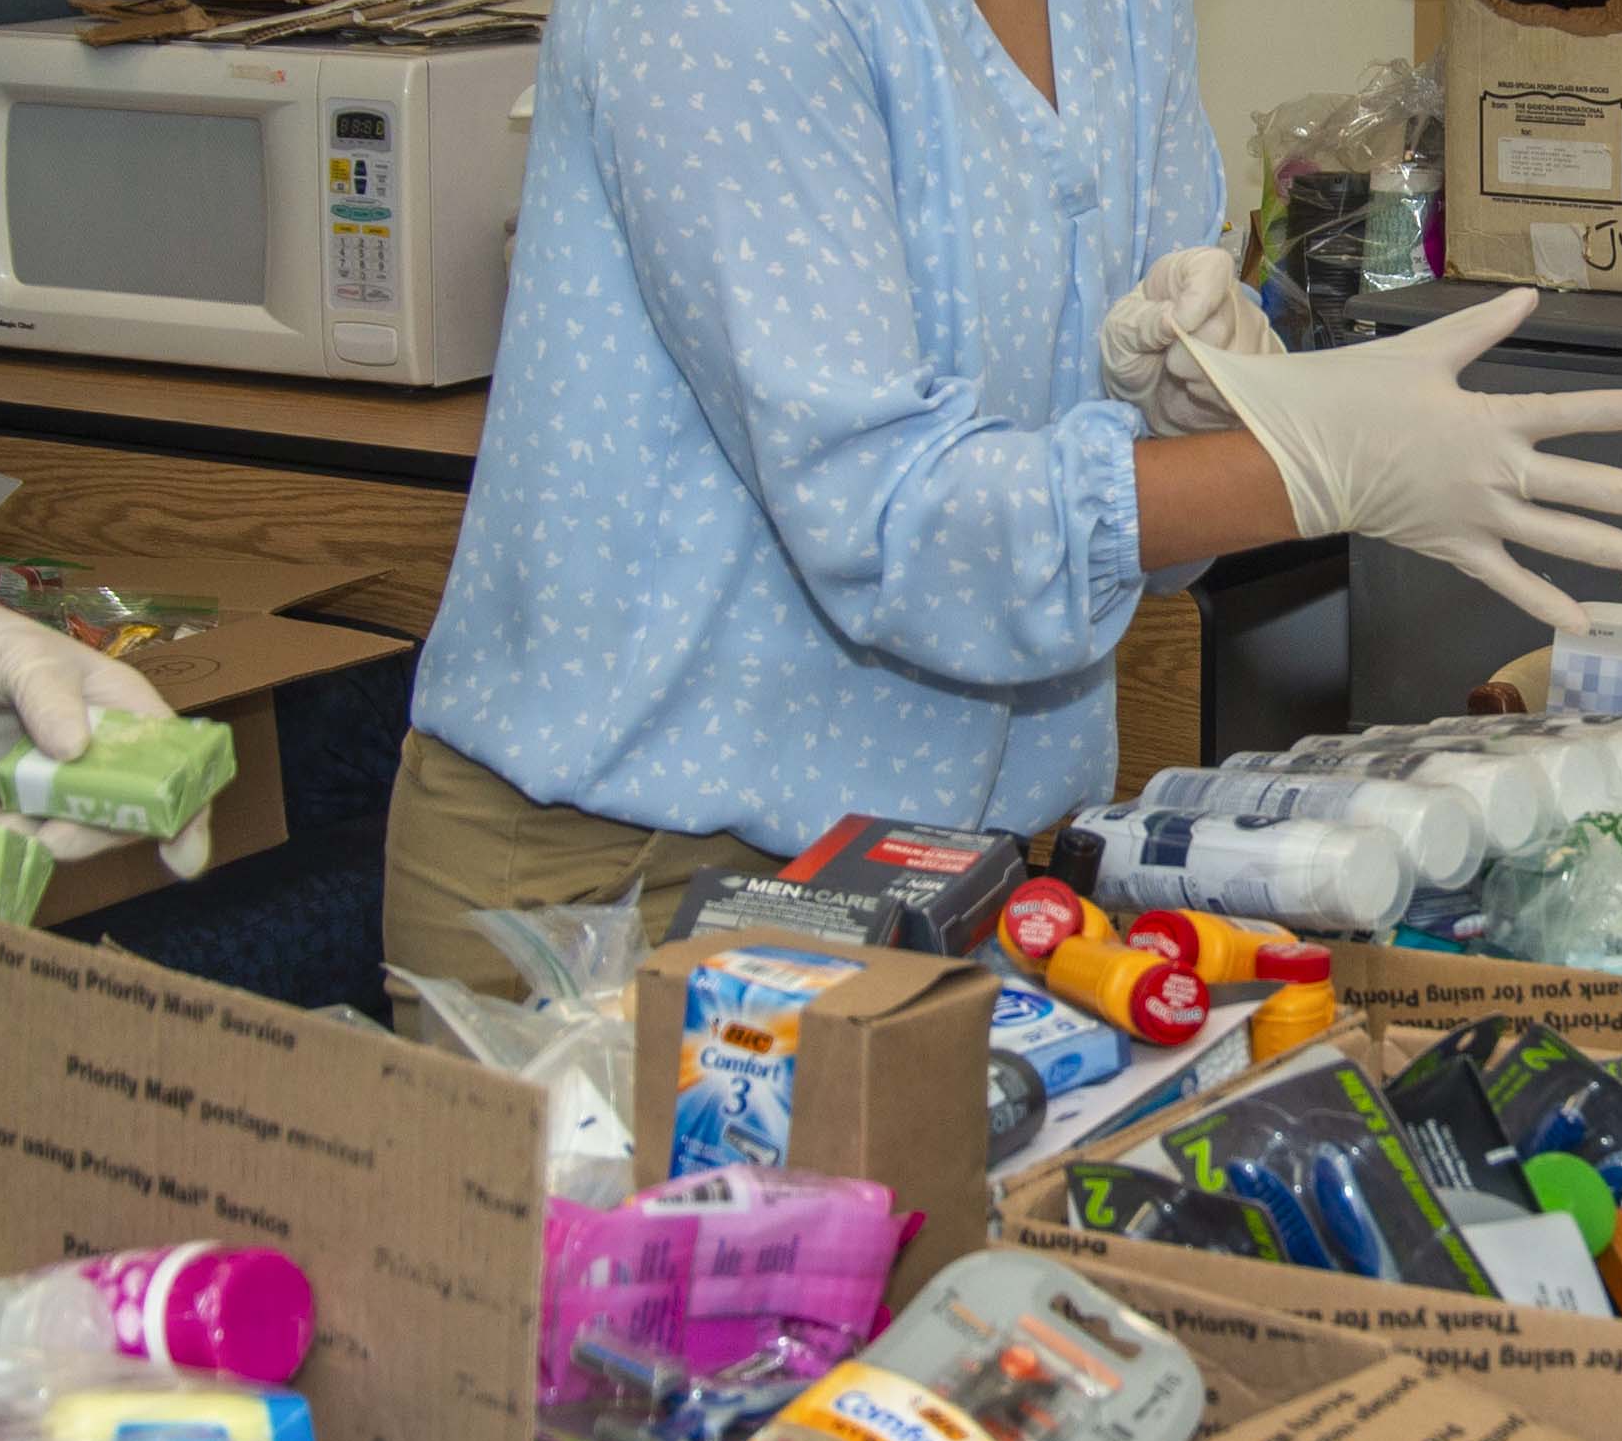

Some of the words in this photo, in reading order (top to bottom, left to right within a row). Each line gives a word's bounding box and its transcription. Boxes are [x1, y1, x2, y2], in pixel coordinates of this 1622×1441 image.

[1343, 987, 1420, 1008] Priority
[1426, 984, 1486, 1004] using
[1492, 982, 1523, 1001] for
[1533, 980, 1572, 1001] you
[30, 957, 79, 988] using
[86, 968, 157, 1014] Priority
[221, 1009, 296, 1051] Service
[700, 1046, 782, 1080] Comfort
[66, 1055, 138, 1098] Priority
[200, 1100, 281, 1142] postage
[723, 1077, 753, 1116] 3
[1334, 1310, 1372, 1331] for
[1379, 1311, 1429, 1333] you
[1436, 1309, 1520, 1335] Thank
[1500, 1346, 1579, 1370] using
